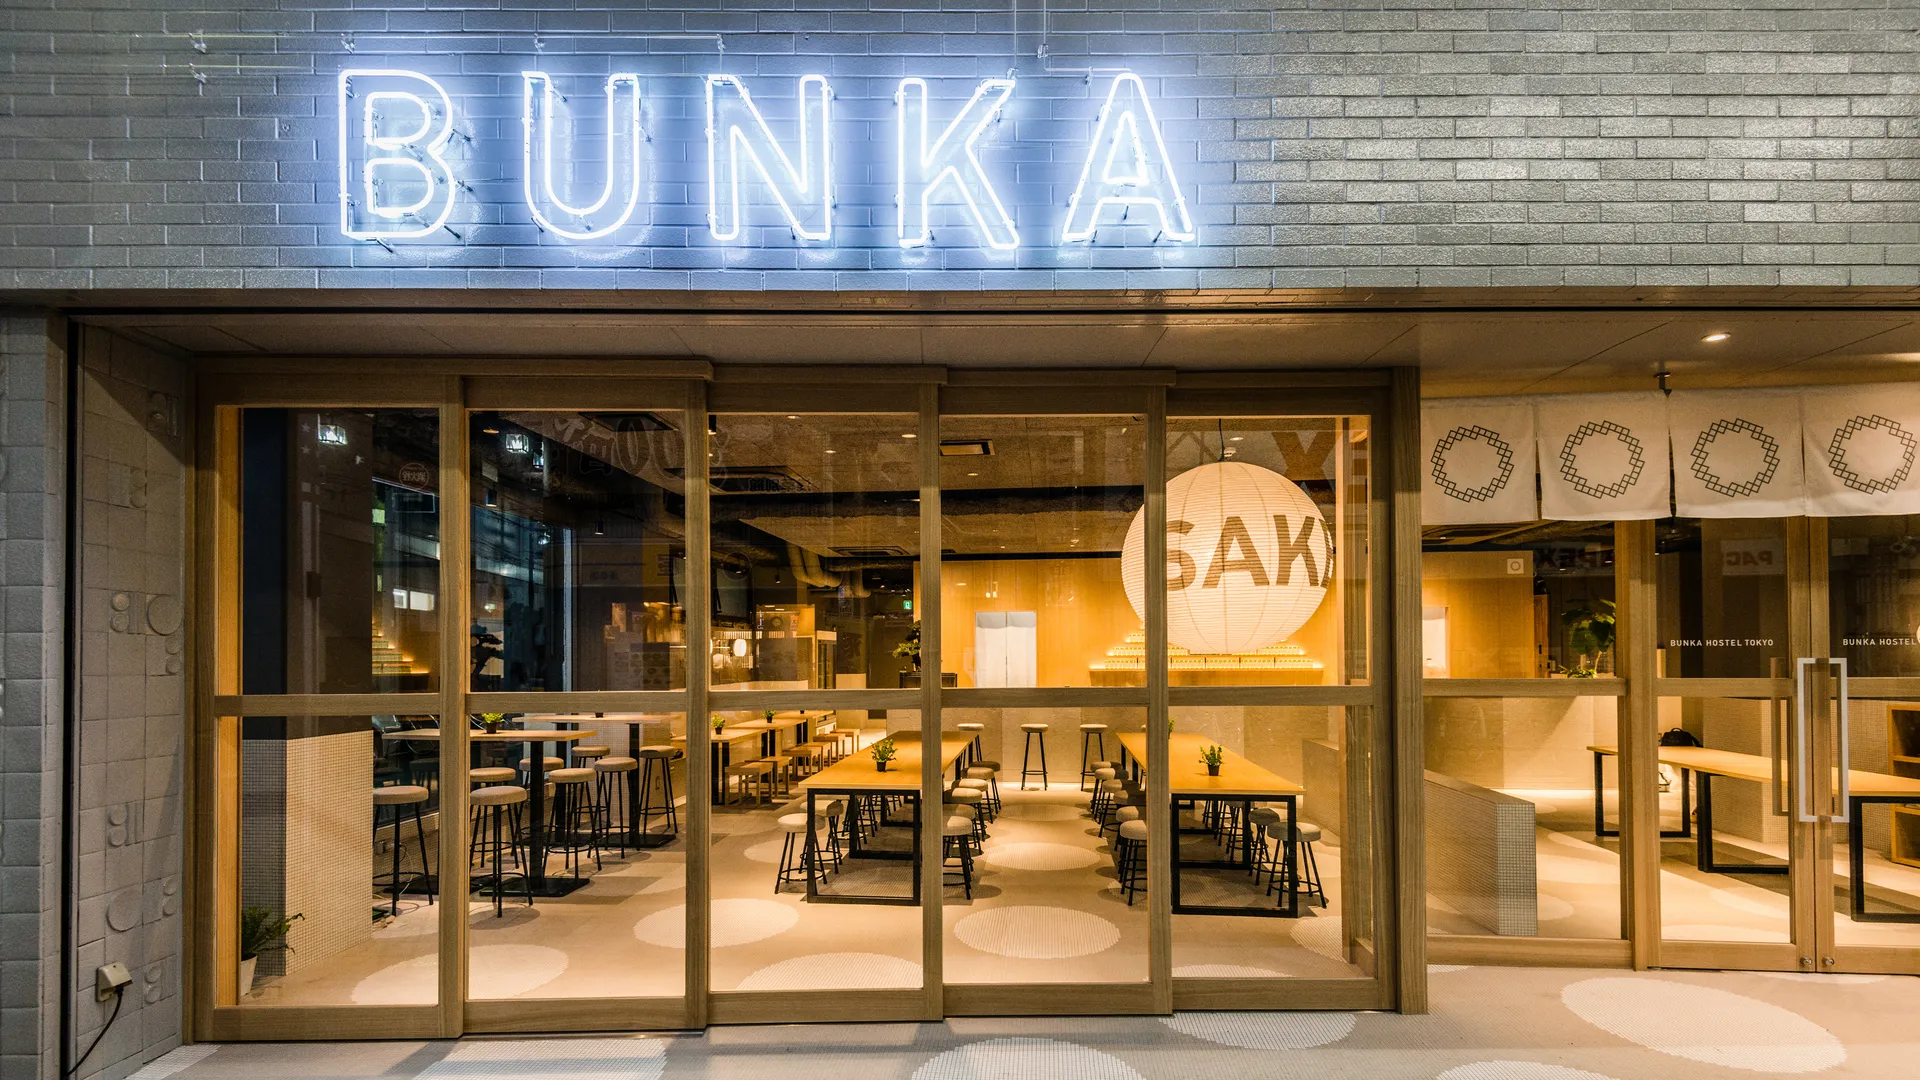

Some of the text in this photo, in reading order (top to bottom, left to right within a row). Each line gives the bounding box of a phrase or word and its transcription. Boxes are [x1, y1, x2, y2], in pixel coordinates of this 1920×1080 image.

[339, 68, 1195, 250] BUNKA
[1166, 514, 1333, 591] SAK
[1670, 638, 1774, 647] BUNKA HOSTEL TOKYO
[1842, 638, 1917, 646] BUNKA HOSTEL
